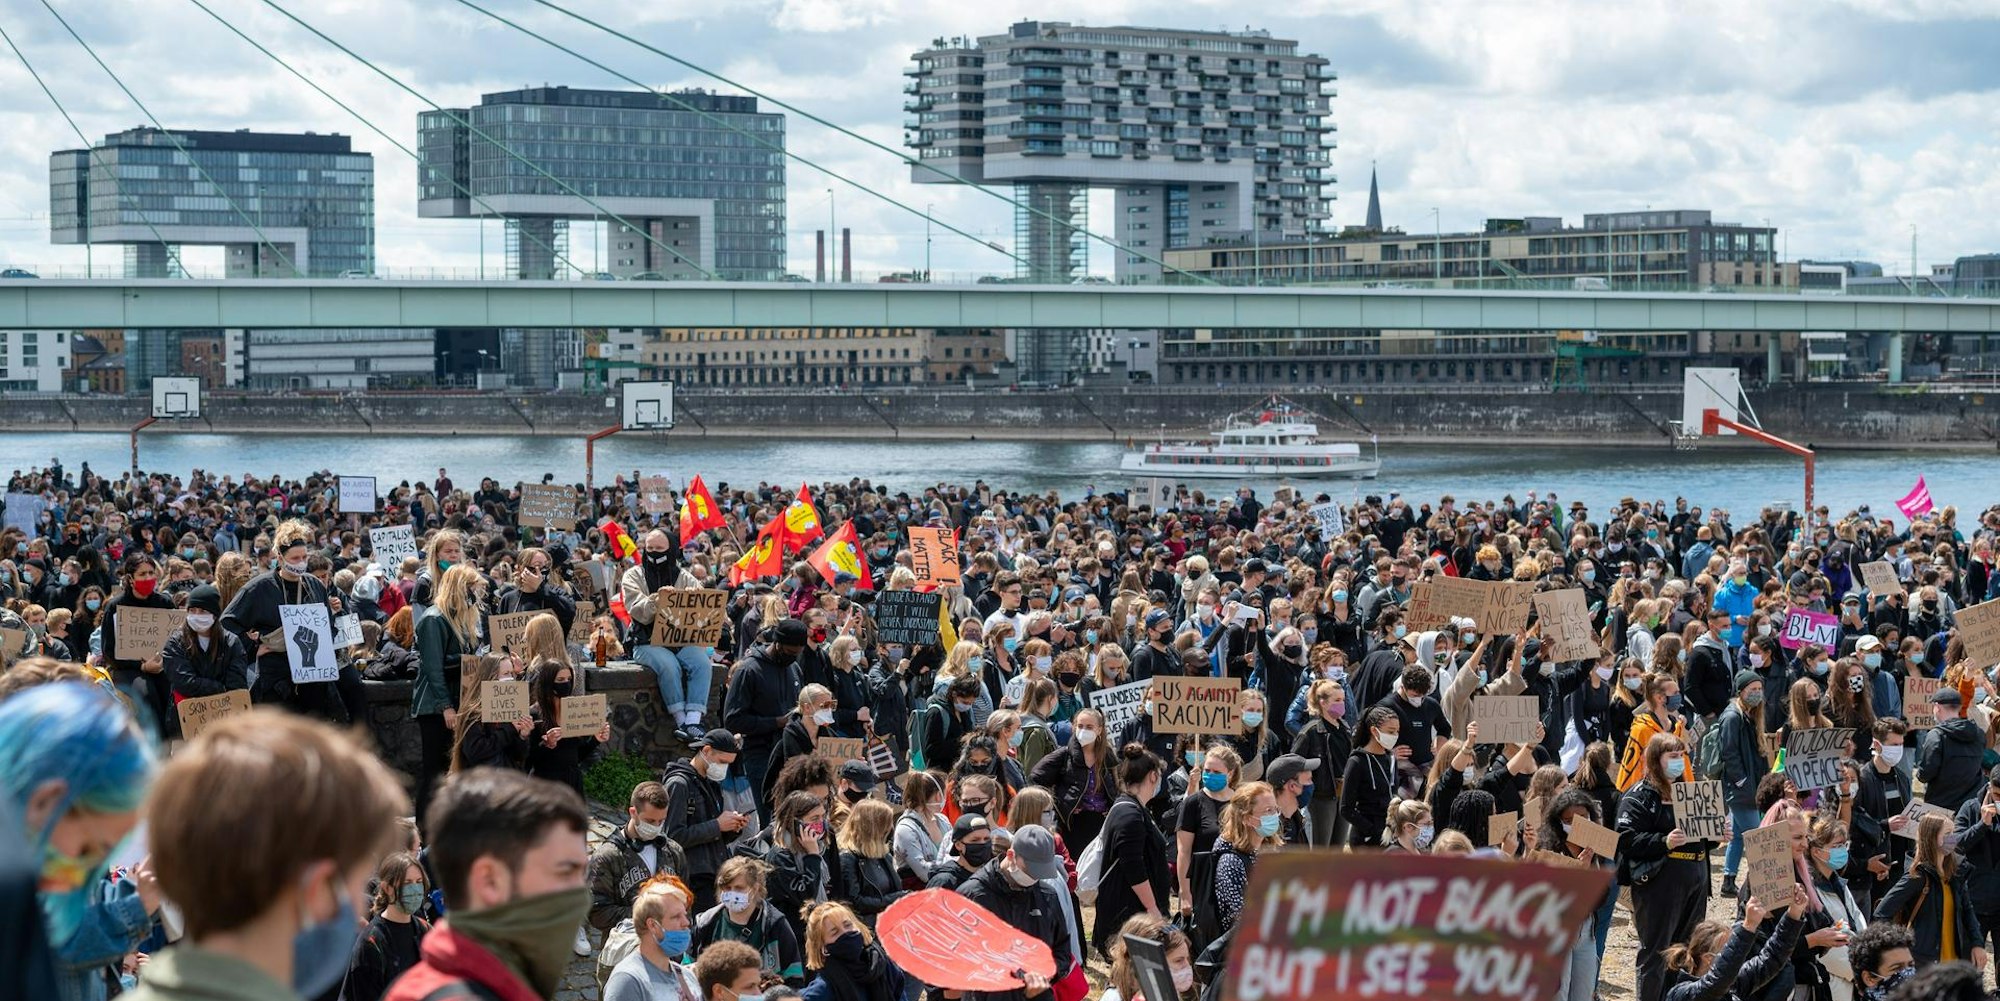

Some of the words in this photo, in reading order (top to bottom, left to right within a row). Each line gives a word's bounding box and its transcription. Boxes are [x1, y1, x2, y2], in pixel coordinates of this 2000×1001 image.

[372, 529, 413, 543] CAPITALISM
[376, 541, 415, 556] THRIVES
[937, 529, 957, 565] BLACK
[389, 556, 403, 565] ON
[912, 537, 931, 581] MATTER
[667, 592, 724, 608] SILENCE
[886, 592, 938, 604] UNDERSTAND
[1490, 585, 1511, 608] NO
[119, 609, 123, 622] I
[130, 612, 159, 624] SEE
[283, 606, 319, 618] BLACK
[683, 612, 697, 626] IS
[881, 605, 898, 616] THAT
[911, 606, 929, 617] WILL
[292, 617, 329, 628] LIVES
[880, 616, 901, 628] NEVER
[1485, 610, 1506, 631] NO
[118, 625, 123, 636] I
[129, 626, 159, 636] HEAR
[660, 627, 719, 644] VIOLENCE
[919, 630, 938, 645] STAND
[1560, 622, 1587, 642] LIVES
[1788, 615, 1836, 645] BLM
[118, 640, 123, 650] I
[129, 640, 158, 649] STAND
[294, 667, 338, 680] MATTER
[493, 684, 519, 696] BLACK
[1093, 696, 1105, 708] I
[1105, 686, 1147, 706] UNDERST
[1186, 686, 1240, 704] AGAINST
[189, 701, 207, 716] SKIN
[210, 695, 232, 710] COLOR
[491, 699, 515, 709] LIVES
[199, 715, 207, 724] IS
[490, 710, 522, 721] MATTER
[821, 743, 858, 759] BLACK
[1786, 731, 1805, 757] NO
[1802, 729, 1855, 754] JUSTICE
[1785, 763, 1803, 789] NO
[1803, 757, 1844, 788] PEACE
[1675, 781, 1720, 802] BLACK
[1684, 799, 1719, 817] LIVES
[1679, 816, 1726, 838] MATTER
[1260, 876, 1330, 942] I'M
[1342, 877, 1438, 936] NOT
[1436, 876, 1577, 949] BLACK,
[1236, 944, 1326, 1001] BUT
[1336, 945, 1351, 993] I
[1358, 942, 1436, 998] SEE
[1454, 942, 1541, 1001] YOU,
